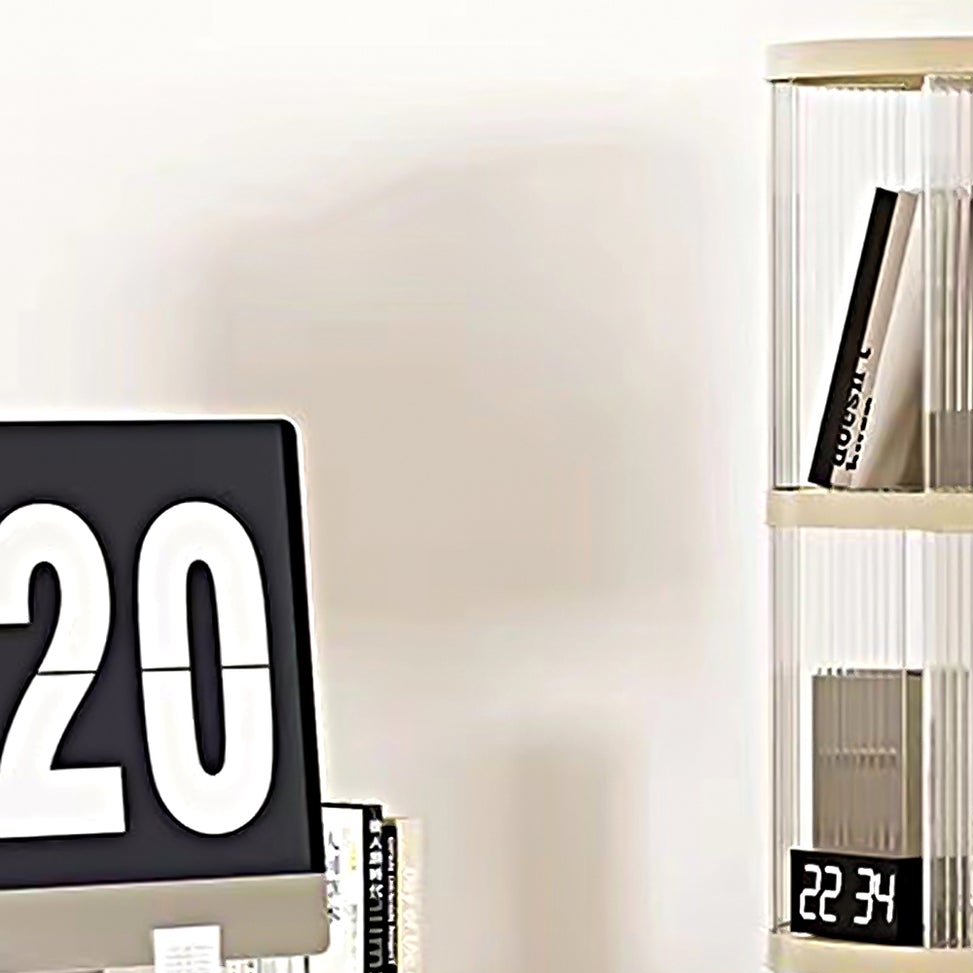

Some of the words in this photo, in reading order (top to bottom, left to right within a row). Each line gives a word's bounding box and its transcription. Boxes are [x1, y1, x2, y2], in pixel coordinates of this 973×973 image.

[0, 501, 274, 837] 20
[799, 863, 842, 923] 22
[853, 867, 896, 925] 34
